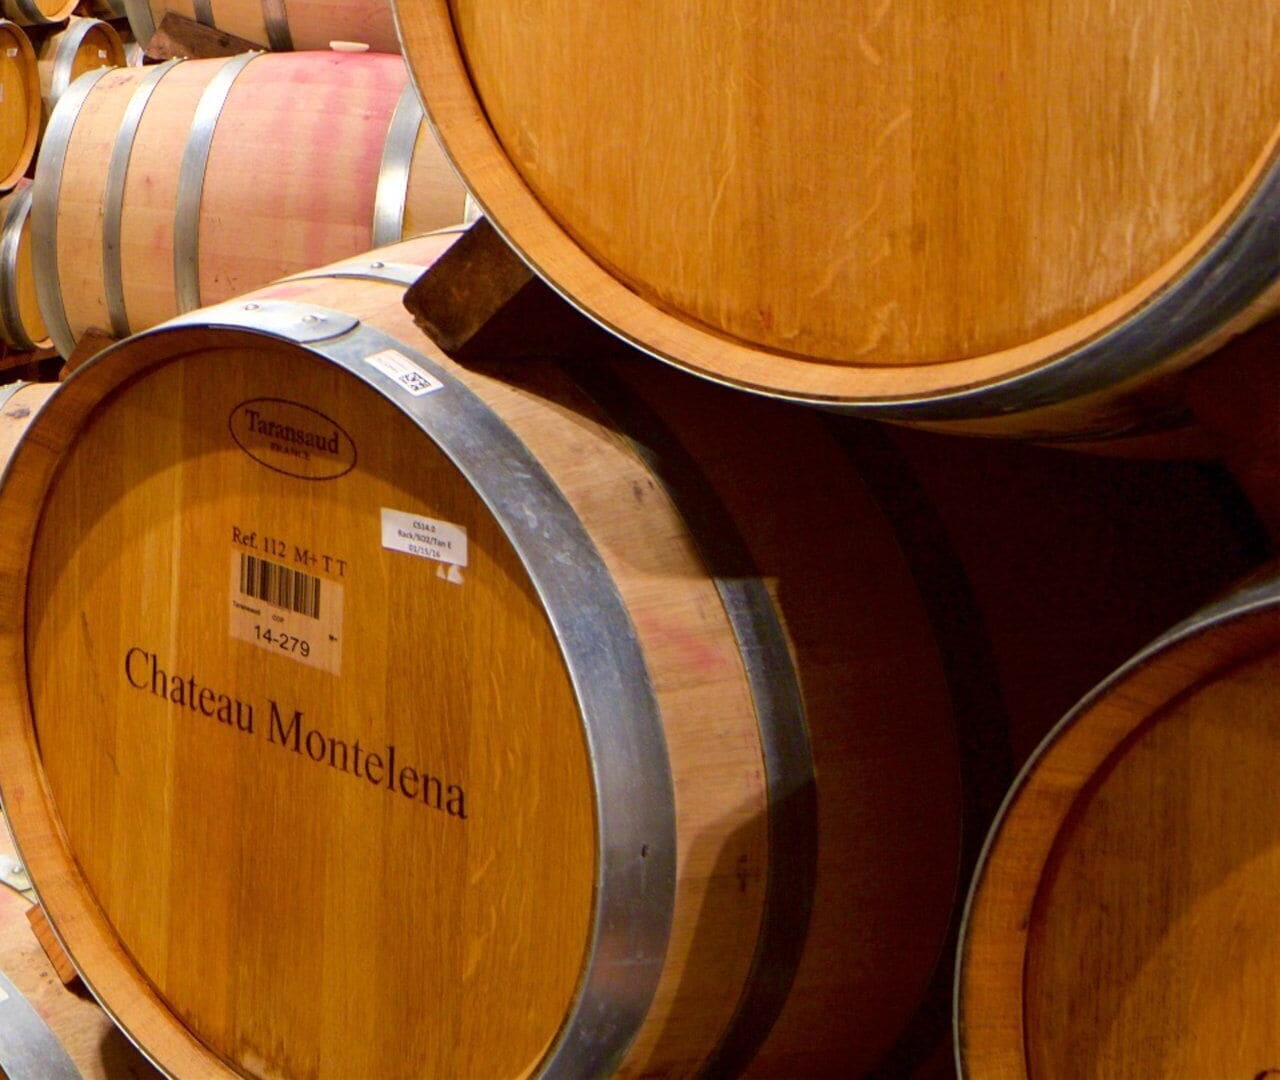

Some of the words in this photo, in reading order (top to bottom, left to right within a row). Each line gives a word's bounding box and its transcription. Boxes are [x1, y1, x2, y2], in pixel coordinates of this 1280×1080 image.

[245, 408, 339, 455] Taransaud
[232, 526, 258, 550] Ref.
[263, 536, 286, 559] 112
[294, 547, 318, 567] M+
[254, 624, 311, 658] 14-279
[124, 647, 255, 735] Chateau
[267, 699, 469, 820] Montelena
